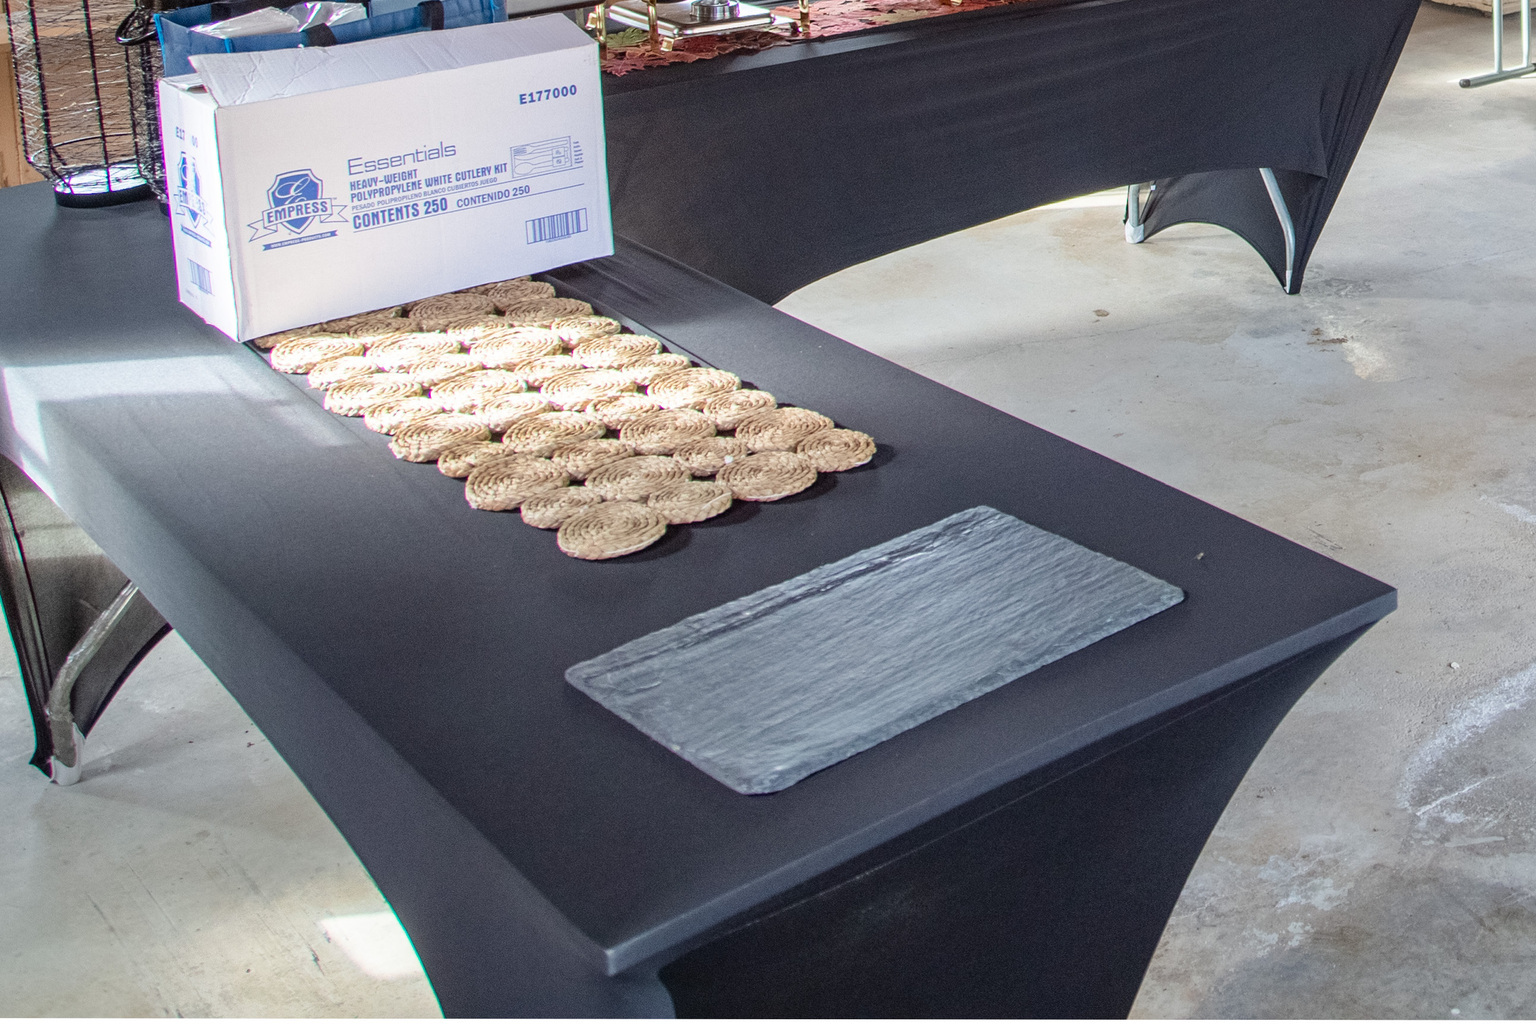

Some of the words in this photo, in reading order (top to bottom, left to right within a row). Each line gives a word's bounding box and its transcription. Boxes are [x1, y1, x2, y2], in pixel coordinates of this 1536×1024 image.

[519, 84, 578, 105] E177000
[347, 141, 457, 176] Essentials
[350, 169, 418, 191] HEAVY-WEIGHT
[350, 179, 423, 203] POLYPROPYLENE
[424, 173, 453, 188] WHITE
[455, 166, 492, 182] CUTLERY
[494, 162, 508, 175] KIT
[352, 202, 375, 211] PESADO
[377, 193, 422, 206] POLIPROPILENO
[423, 187, 447, 197] BLANCO
[447, 181, 479, 193] CUBIERTOS
[479, 176, 498, 186] JUEGO
[266, 201, 328, 223] EMPRESS
[353, 203, 420, 229] CONTENTS
[423, 197, 448, 215] 250
[456, 189, 510, 208] CONTENIDO
[512, 184, 531, 196] 250
